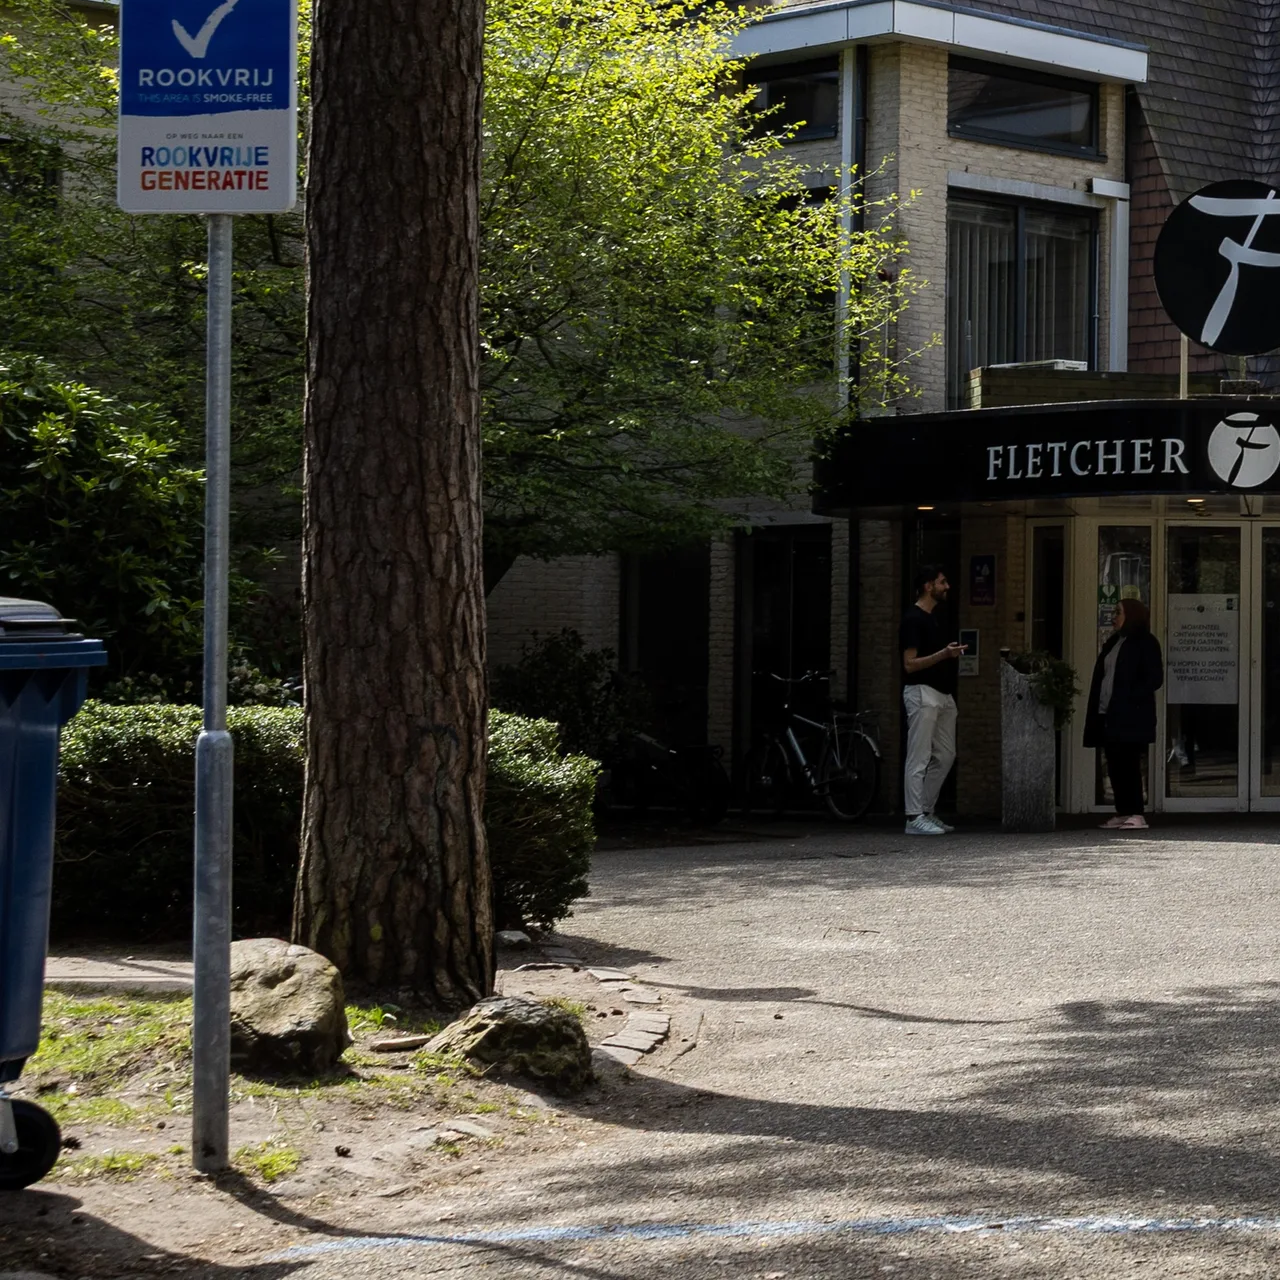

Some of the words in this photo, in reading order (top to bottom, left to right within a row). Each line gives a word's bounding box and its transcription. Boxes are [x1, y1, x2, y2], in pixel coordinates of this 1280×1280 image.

[138, 68, 273, 86] ROOKVRIJ
[138, 93, 161, 103] THIS
[163, 93, 190, 103] AREA
[192, 93, 201, 103] IS
[203, 93, 273, 103] SMOKE-FREE
[141, 146, 269, 167] ROOKVRIJE
[141, 170, 269, 191] GENERATIE
[986, 438, 1190, 481] FLETCHER
